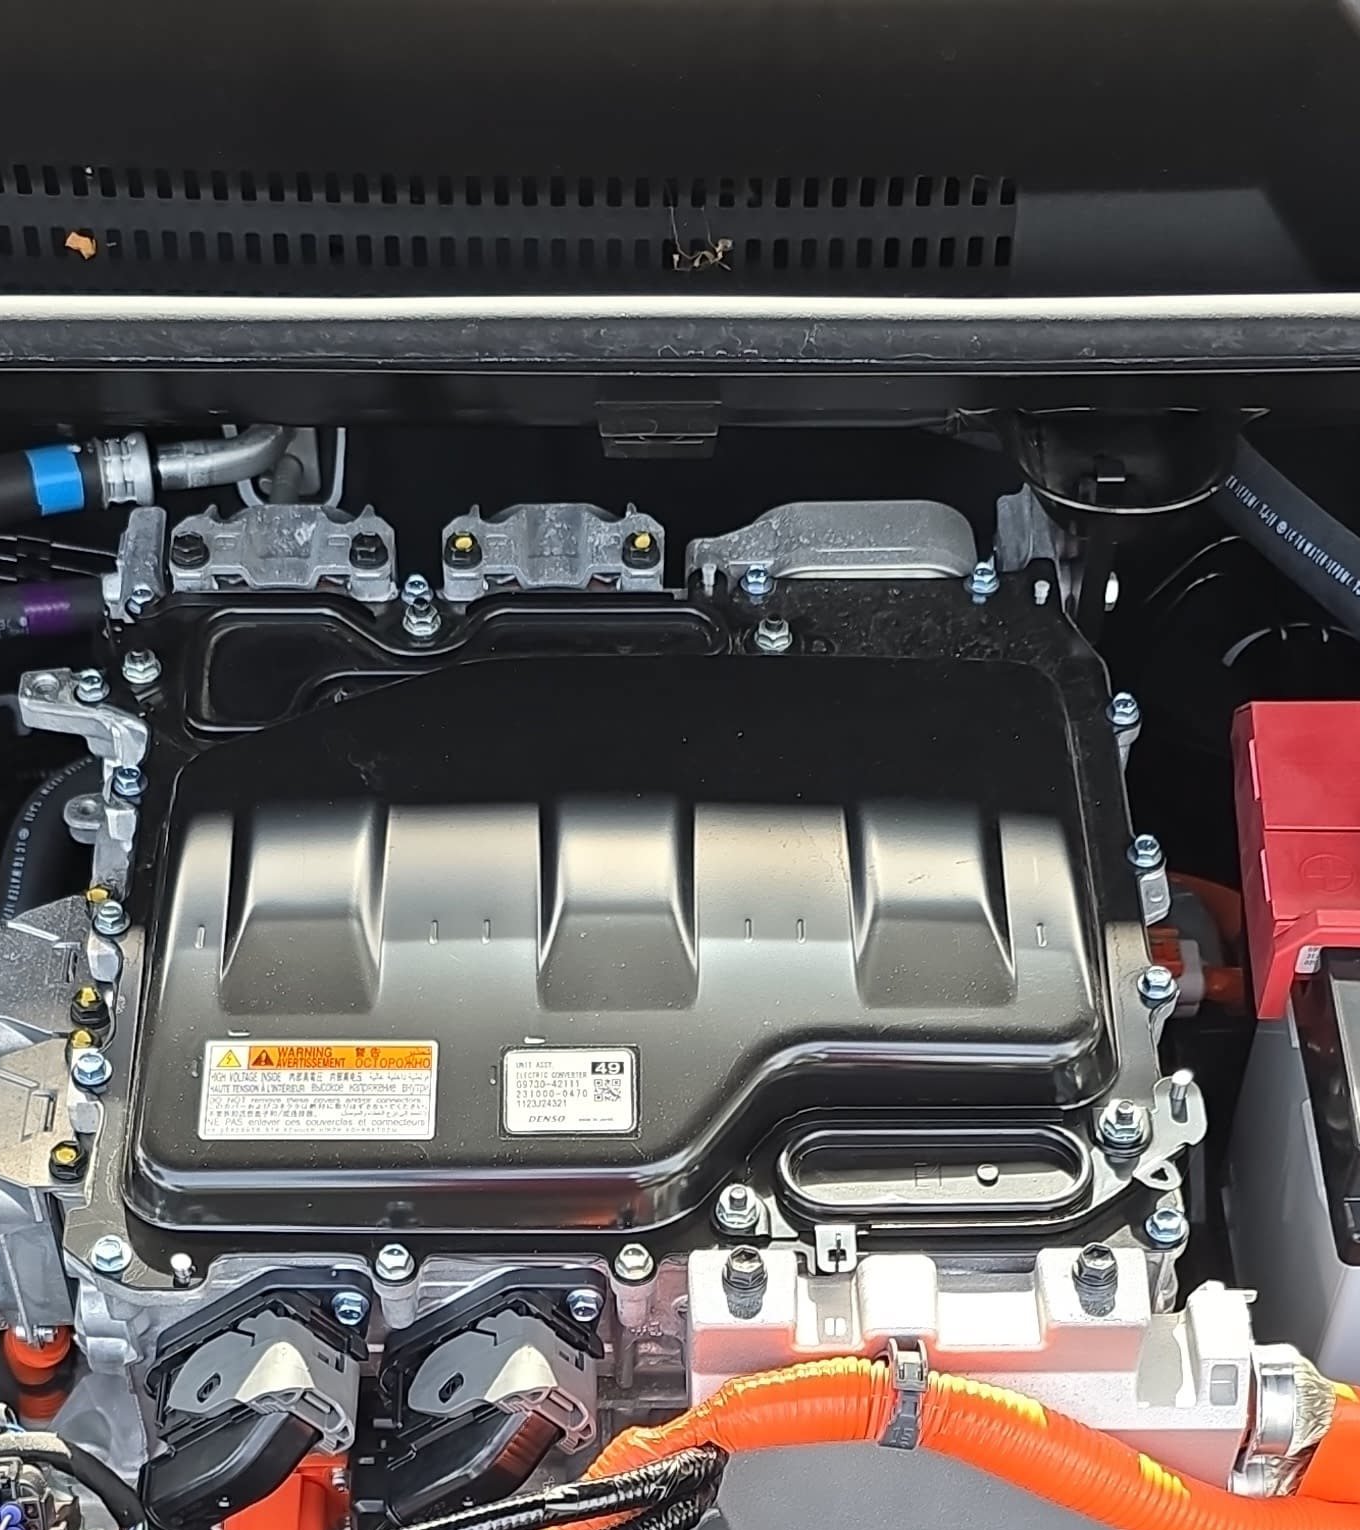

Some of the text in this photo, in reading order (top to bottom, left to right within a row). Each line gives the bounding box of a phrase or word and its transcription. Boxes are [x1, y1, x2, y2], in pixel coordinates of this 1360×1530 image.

[277, 1047, 332, 1058] WARNING
[276, 1057, 346, 1068] AVERTISSEMENT
[355, 1058, 431, 1069] ОСТОРОЖНО
[594, 1062, 621, 1074] 49
[229, 1072, 257, 1082] VOLTAGE
[261, 1072, 281, 1082] INSIDE
[210, 1084, 229, 1093] HAUTE
[232, 1084, 259, 1093] TENSION
[516, 1089, 588, 1098] 231000-0470
[225, 1118, 243, 1127] PAS
[528, 1115, 566, 1123] DENSO
